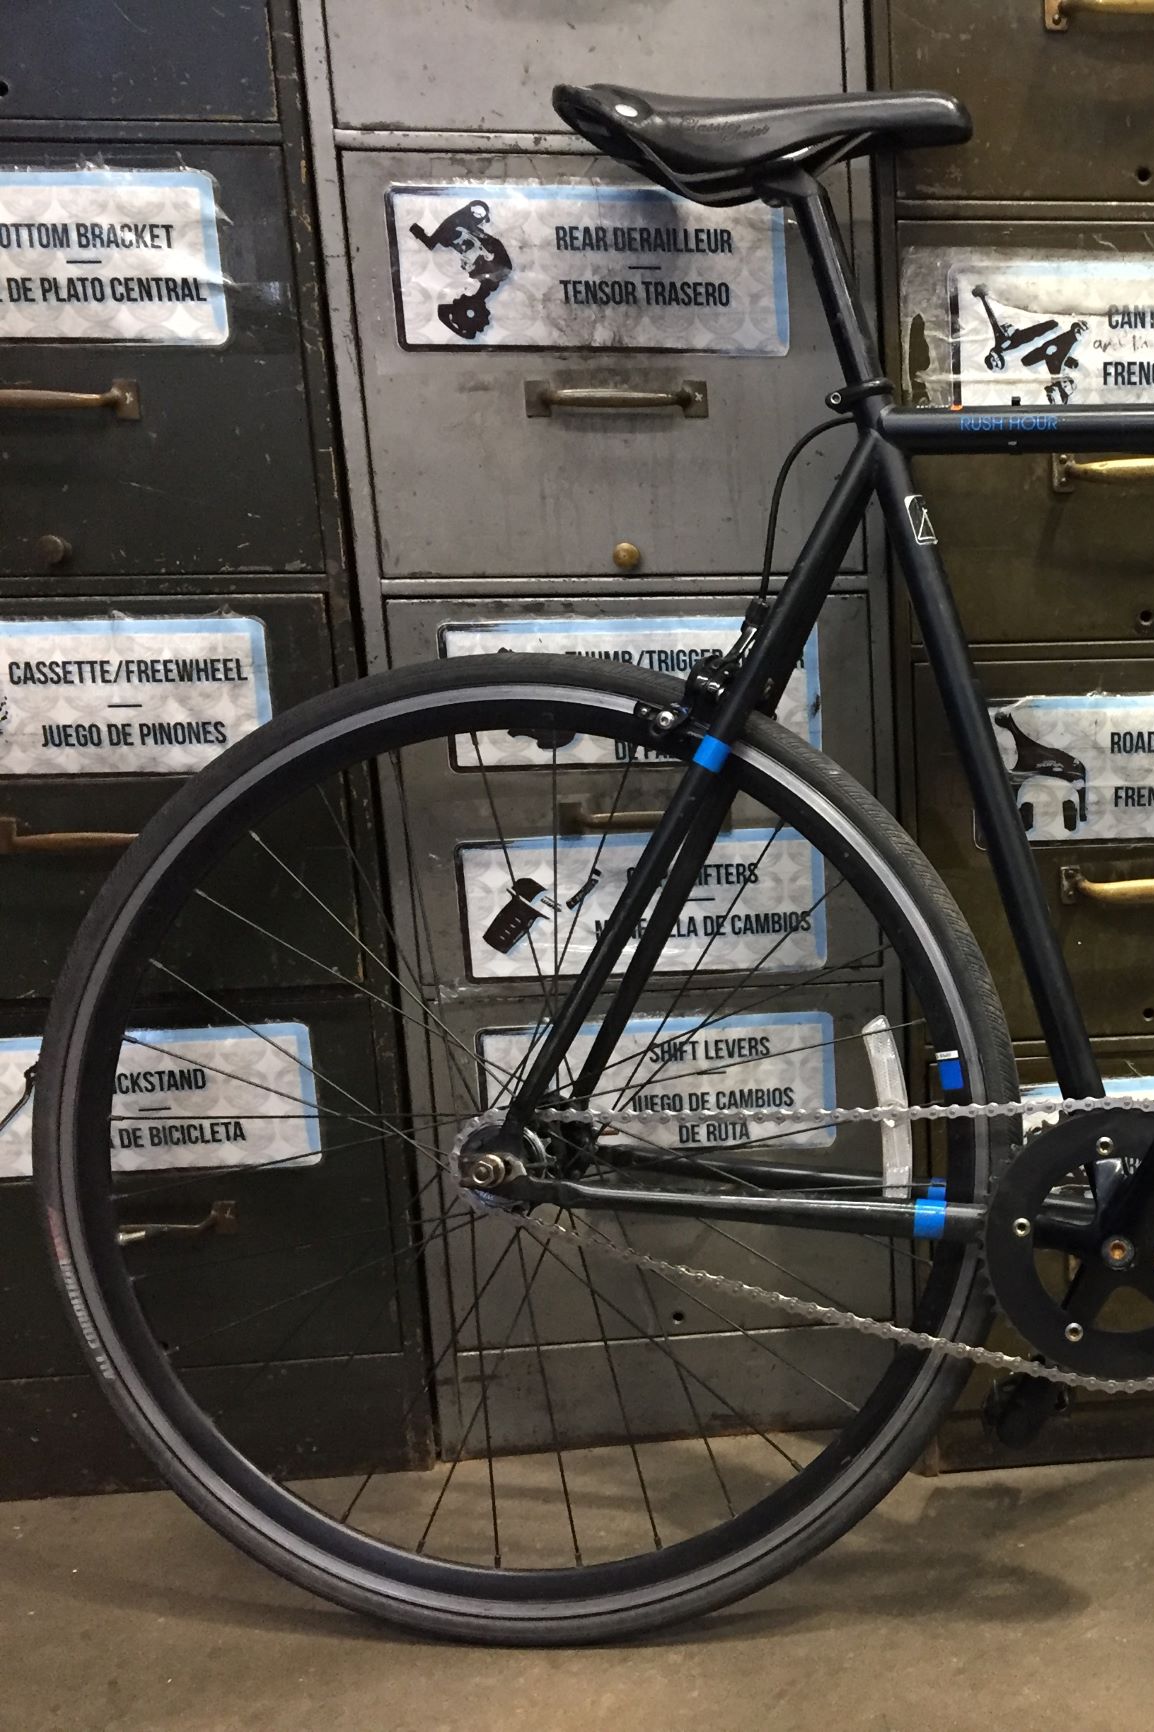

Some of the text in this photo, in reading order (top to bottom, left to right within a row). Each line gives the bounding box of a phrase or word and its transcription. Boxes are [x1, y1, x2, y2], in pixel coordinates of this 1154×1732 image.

[0, 223, 174, 249] OTTOM BRACKET
[555, 226, 732, 254] REAR DERAILLEUR
[8, 277, 207, 302] DE PLATO CENTRAL
[560, 279, 730, 307] TENSOR TRASERO
[960, 415, 1059, 431] RUSH HOUR
[8, 658, 248, 685] CASSETTE/FREEWHEEL
[41, 721, 227, 748] JUEGO DE PINONES
[703, 914, 726, 937] DE
[731, 910, 812, 935] CAMBIOS
[650, 1036, 770, 1063] SHIFT LEVERS
[112, 1068, 206, 1095] CKSTAND
[689, 1091, 711, 1112] DE
[715, 1087, 795, 1111] CAMBIOS
[119, 1127, 143, 1149] DE
[149, 1120, 246, 1148] BICICLETA
[678, 1121, 751, 1144] DE RUTA
